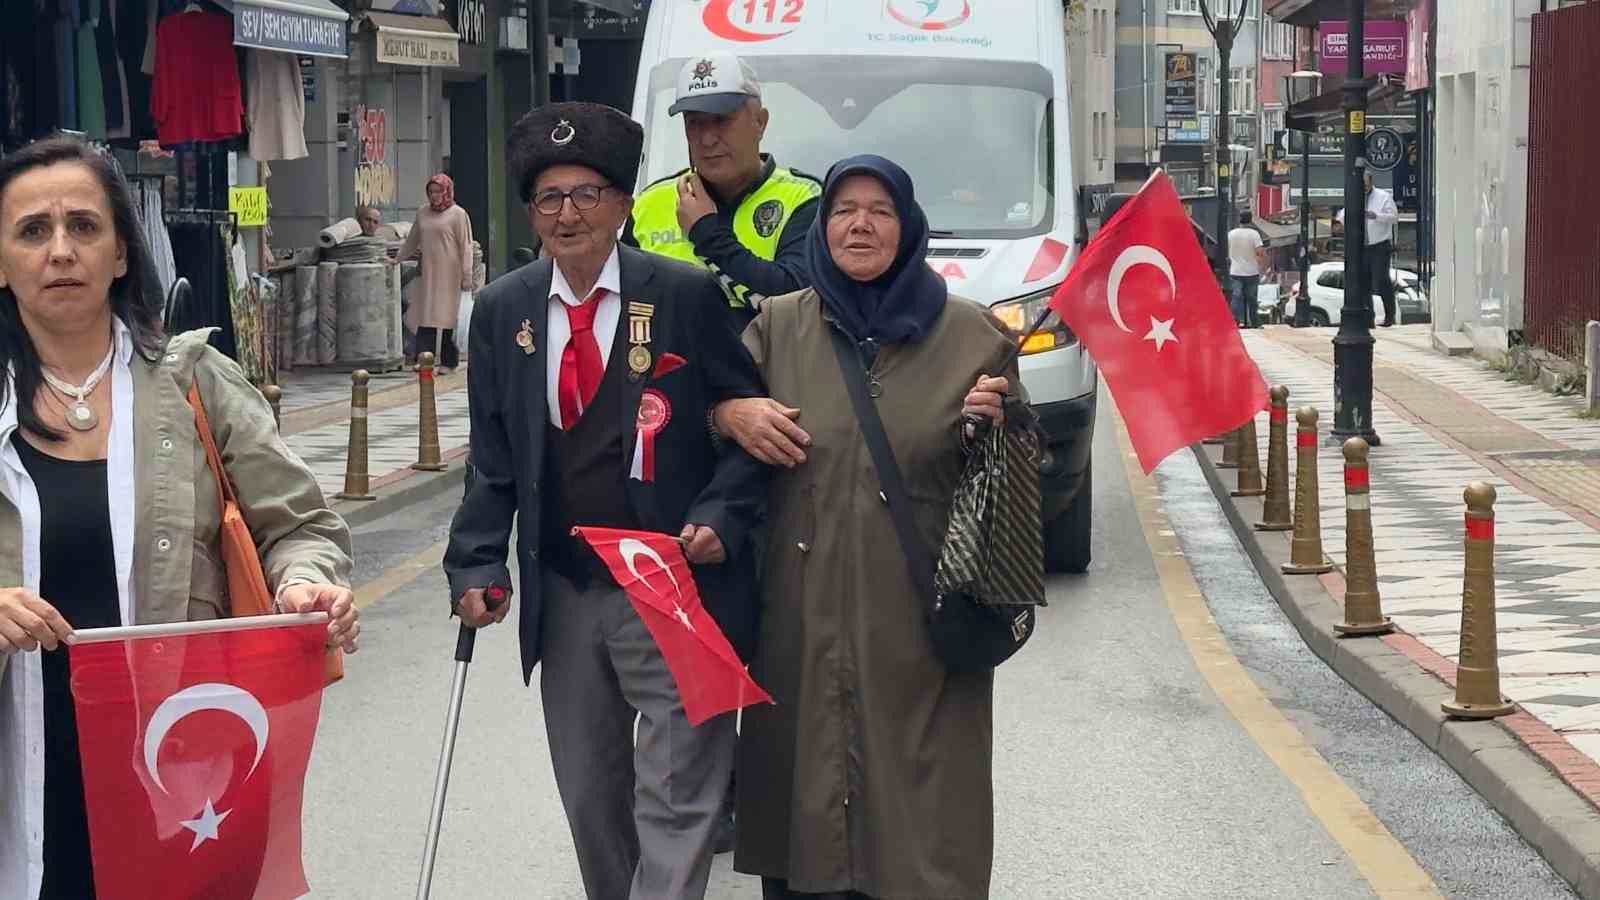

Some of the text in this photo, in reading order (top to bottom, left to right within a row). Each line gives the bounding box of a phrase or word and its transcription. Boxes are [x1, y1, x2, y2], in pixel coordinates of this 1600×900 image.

[743, 0, 805, 24] 112
[1327, 45, 1347, 54] YAP
[688, 79, 719, 92] POLİS
[650, 229, 686, 247] POL
